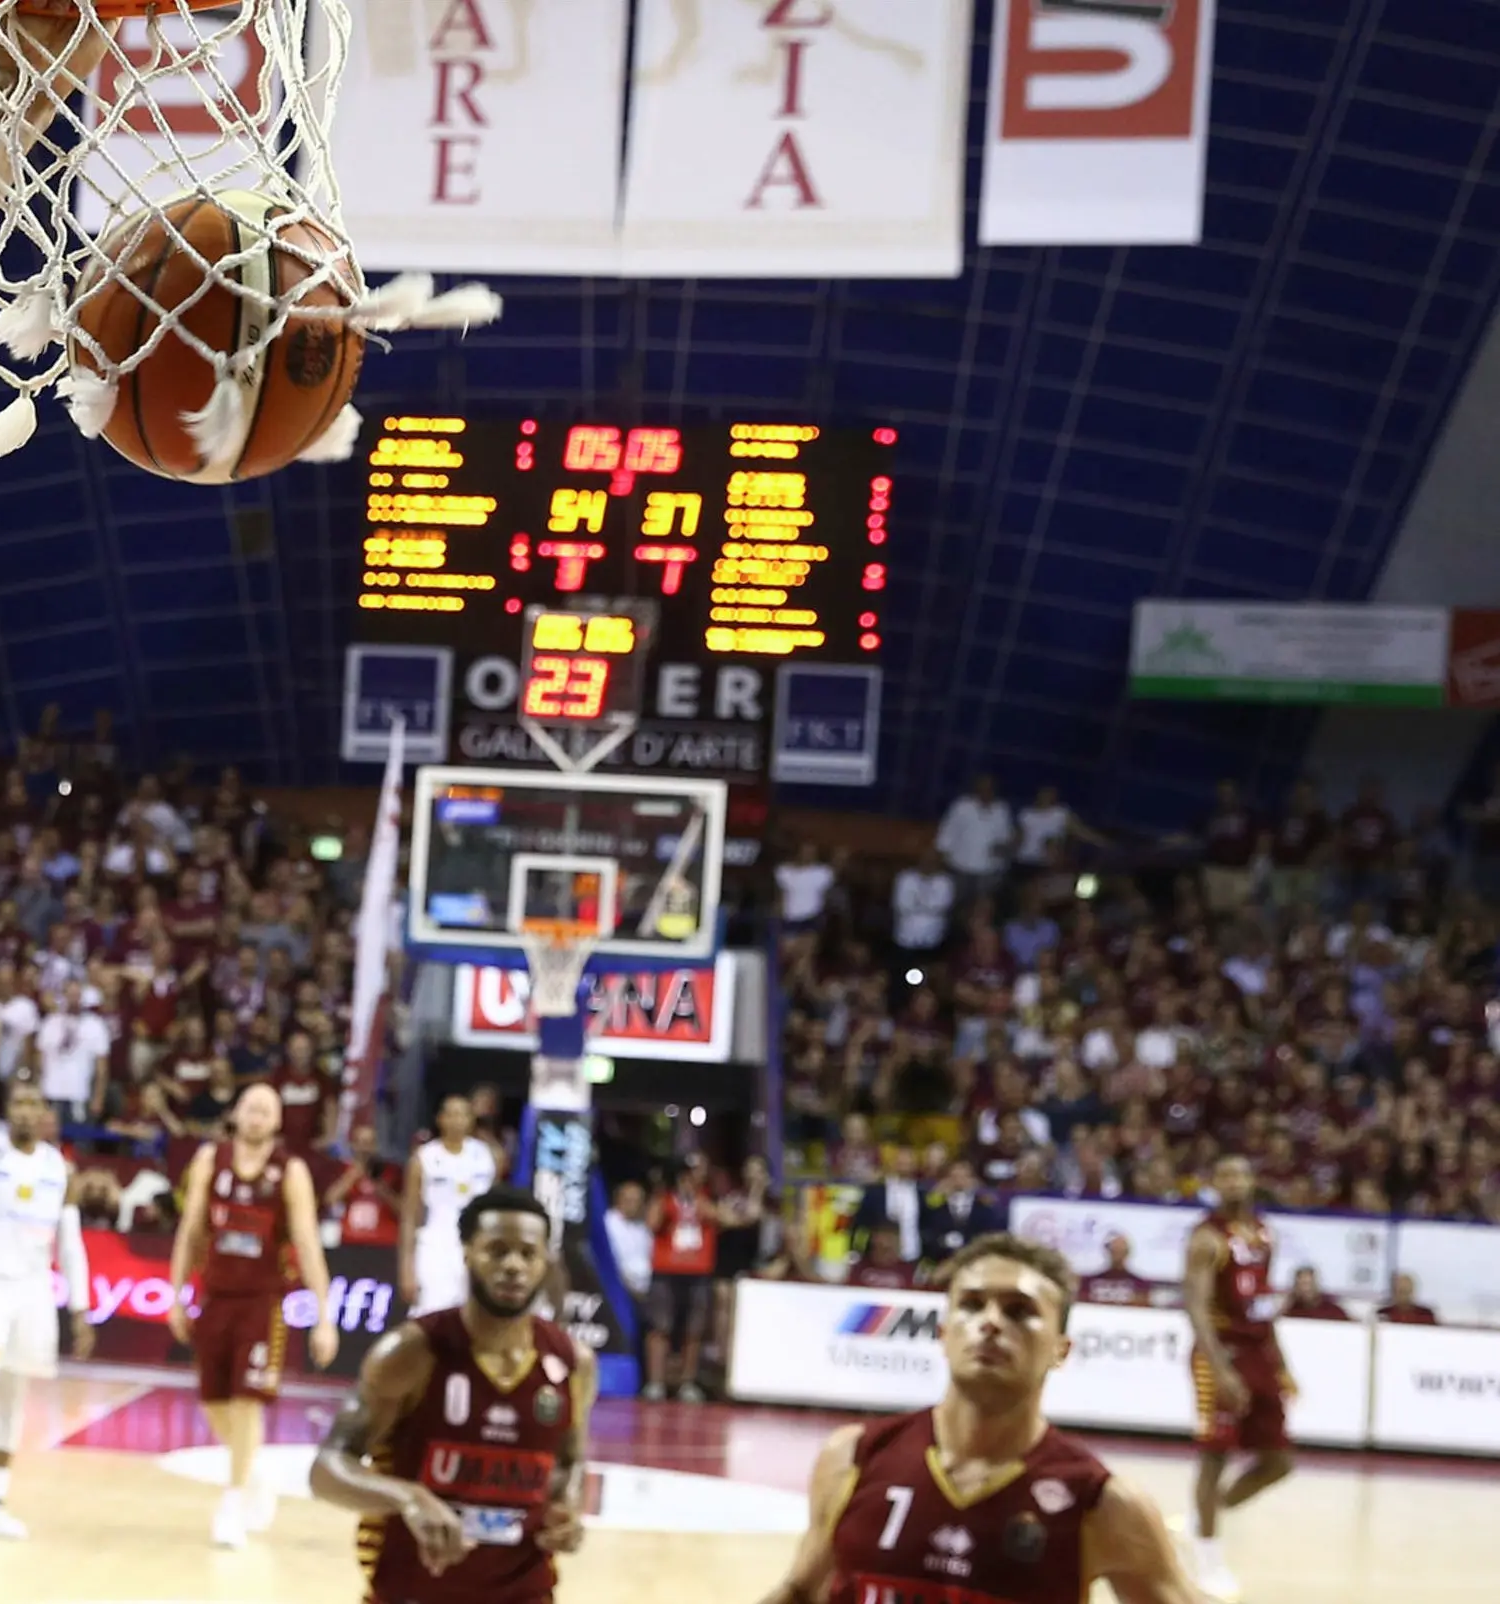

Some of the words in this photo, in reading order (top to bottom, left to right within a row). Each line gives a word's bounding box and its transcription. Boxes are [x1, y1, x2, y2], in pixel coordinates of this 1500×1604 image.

[547, 488, 608, 533] 54
[464, 655, 764, 719] OER
[523, 655, 608, 719] 23
[877, 1485, 915, 1550] 7
